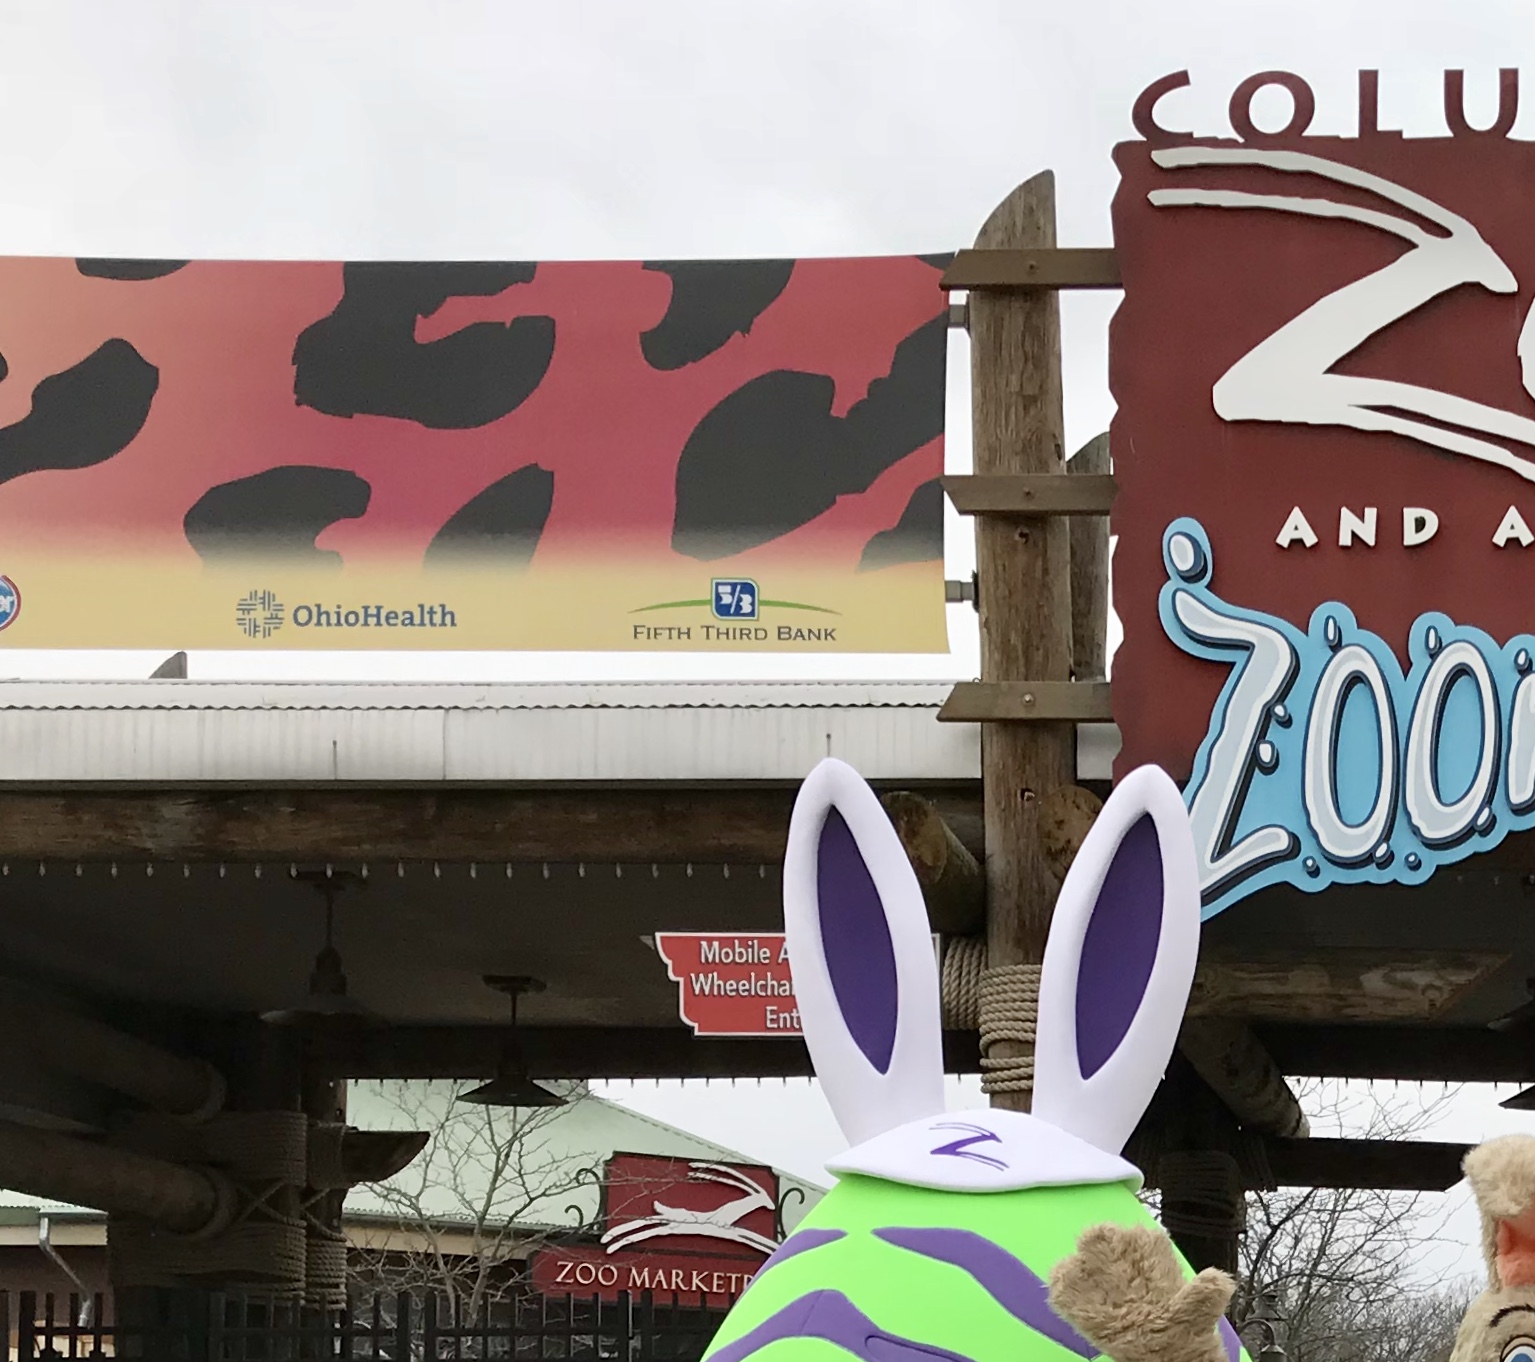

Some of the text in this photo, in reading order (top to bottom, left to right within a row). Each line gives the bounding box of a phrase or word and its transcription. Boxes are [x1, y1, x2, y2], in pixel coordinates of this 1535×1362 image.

[1276, 504, 1439, 549] AND
[292, 603, 458, 627] OhioHealth
[632, 624, 838, 642] FIFTH THIRD BANK
[700, 938, 771, 964] Mobile
[554, 1260, 618, 1286] ZOO
